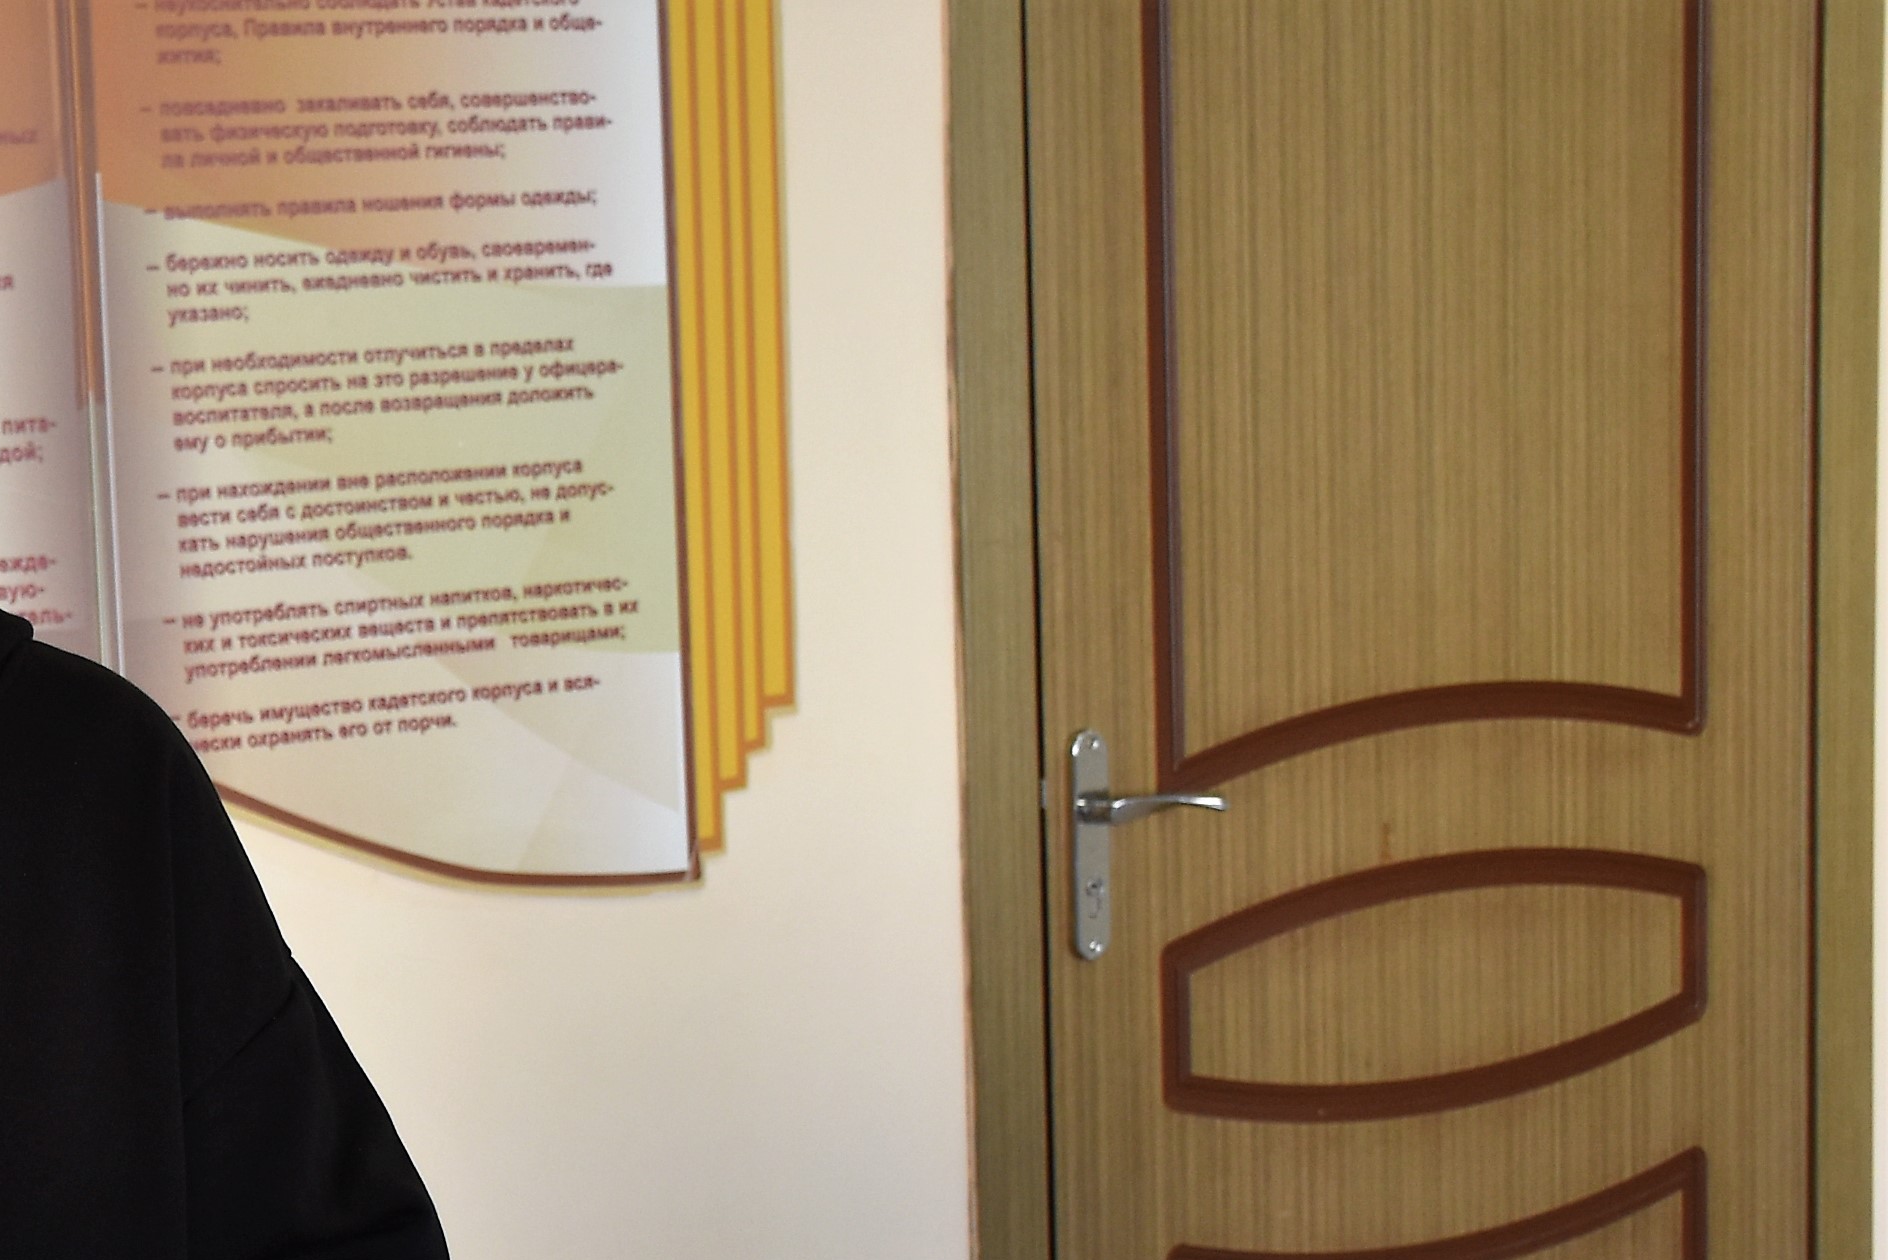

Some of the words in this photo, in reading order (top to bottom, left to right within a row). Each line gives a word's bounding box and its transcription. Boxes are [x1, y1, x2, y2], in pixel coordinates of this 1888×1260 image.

[165, 251, 249, 276] бережно
[253, 250, 320, 269] носить
[325, 247, 395, 269] одежду
[481, 239, 596, 263] своевремен-
[301, 271, 405, 294] ежедневно
[409, 267, 482, 287] чистить
[585, 261, 614, 281] где
[170, 357, 206, 379] при
[211, 348, 359, 373] необходимости
[363, 342, 469, 368] отлучиться
[489, 337, 574, 362] пределах
[171, 379, 249, 404] корпуса
[253, 374, 342, 399] спросить
[374, 371, 405, 389] это
[408, 364, 519, 392] разрешение
[538, 357, 623, 384] офицера-
[319, 398, 376, 417] после
[379, 390, 503, 416] возвращения
[506, 385, 595, 409] доложить
[1, 418, 56, 437] пита-
[173, 433, 209, 455] ему
[176, 484, 212, 506] при
[216, 475, 332, 499] нахождении
[336, 473, 371, 491] вне
[511, 458, 584, 483] корпуса
[177, 508, 232, 528] вести
[236, 500, 281, 523] себя
[300, 493, 434, 522] достоинством
[555, 481, 614, 504] допус-
[178, 533, 221, 552] кать
[225, 525, 330, 552] нарушения
[334, 515, 477, 543] общественного
[480, 509, 555, 534] порядка
[179, 550, 307, 578] недостойных
[209, 600, 330, 631] употреблять
[334, 593, 425, 618] спиртных
[522, 577, 629, 604] наркотичес-
[183, 634, 215, 653] ких
[238, 623, 352, 648] токсических
[357, 616, 436, 640] веществ
[456, 603, 599, 635] препятствовать
[184, 651, 318, 682] употреблении
[322, 636, 496, 666] легкомысленными
[187, 705, 255, 730] беречь
[259, 695, 364, 724] имущество
[368, 686, 467, 712] кадетского
[471, 679, 544, 704] корпуса
[563, 674, 600, 693] вся-
[247, 723, 334, 750] охранять
[338, 720, 369, 739] его
